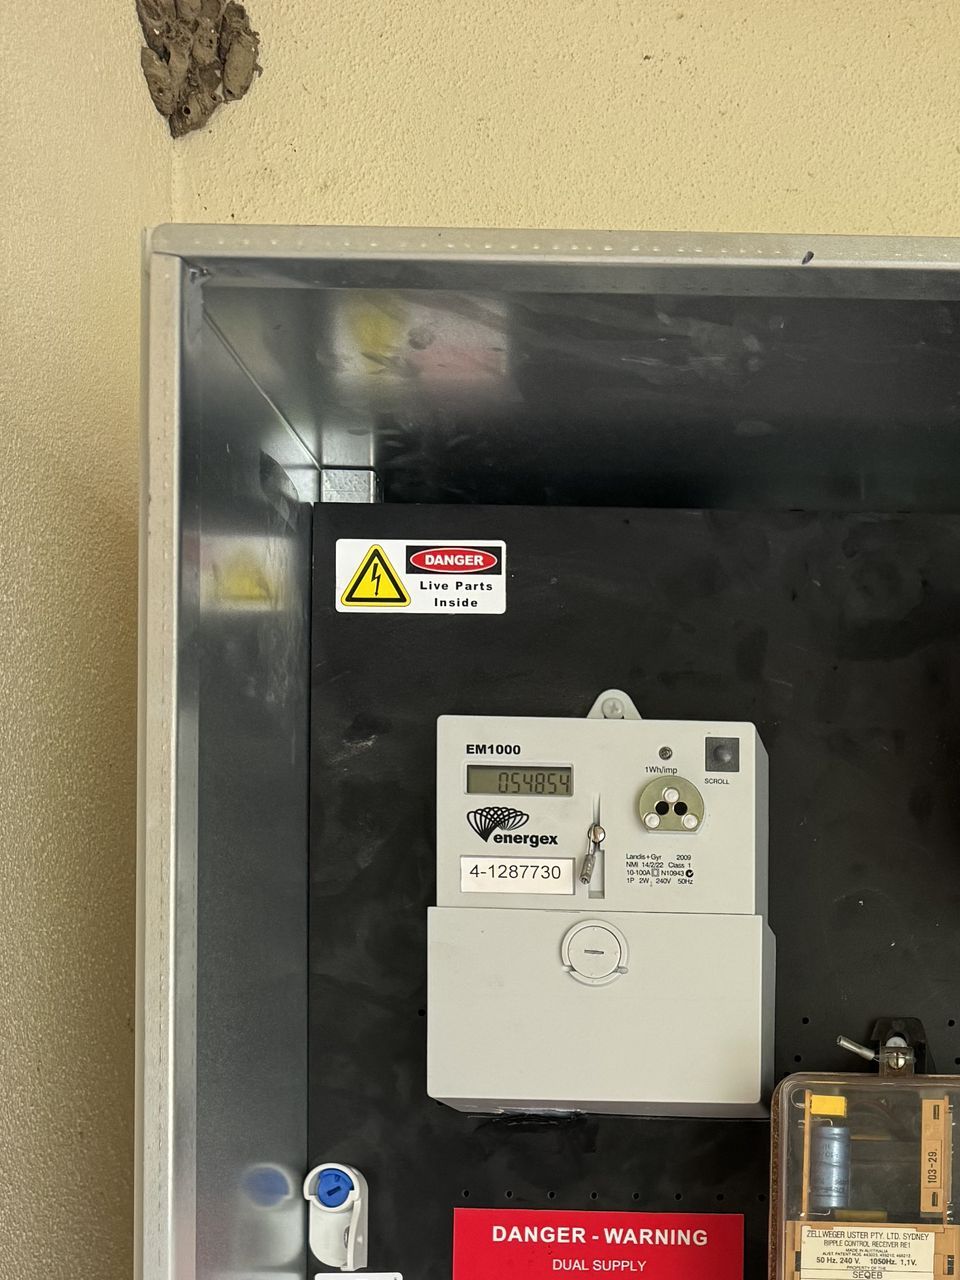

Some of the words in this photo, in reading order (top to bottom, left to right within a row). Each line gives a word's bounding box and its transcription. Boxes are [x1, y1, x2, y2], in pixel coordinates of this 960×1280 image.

[425, 554, 483, 566] DANGER
[420, 581, 448, 590] Live
[456, 581, 492, 591] Parts
[435, 598, 478, 607] Inside
[466, 744, 521, 755] EM1000
[645, 766, 677, 775] 1Wh/imp
[498, 773, 570, 794] 054854
[493, 832, 558, 847] energex
[470, 864, 561, 879] 4-1287730
[492, 1226, 586, 1243] DANGER
[604, 1228, 708, 1246] WARNING
[807, 1230, 845, 1238] ZELLWEGER
[552, 1259, 589, 1270] DUAL
[592, 1260, 646, 1272] SUPPLY
[852, 1271, 883, 1279] SEQEB
